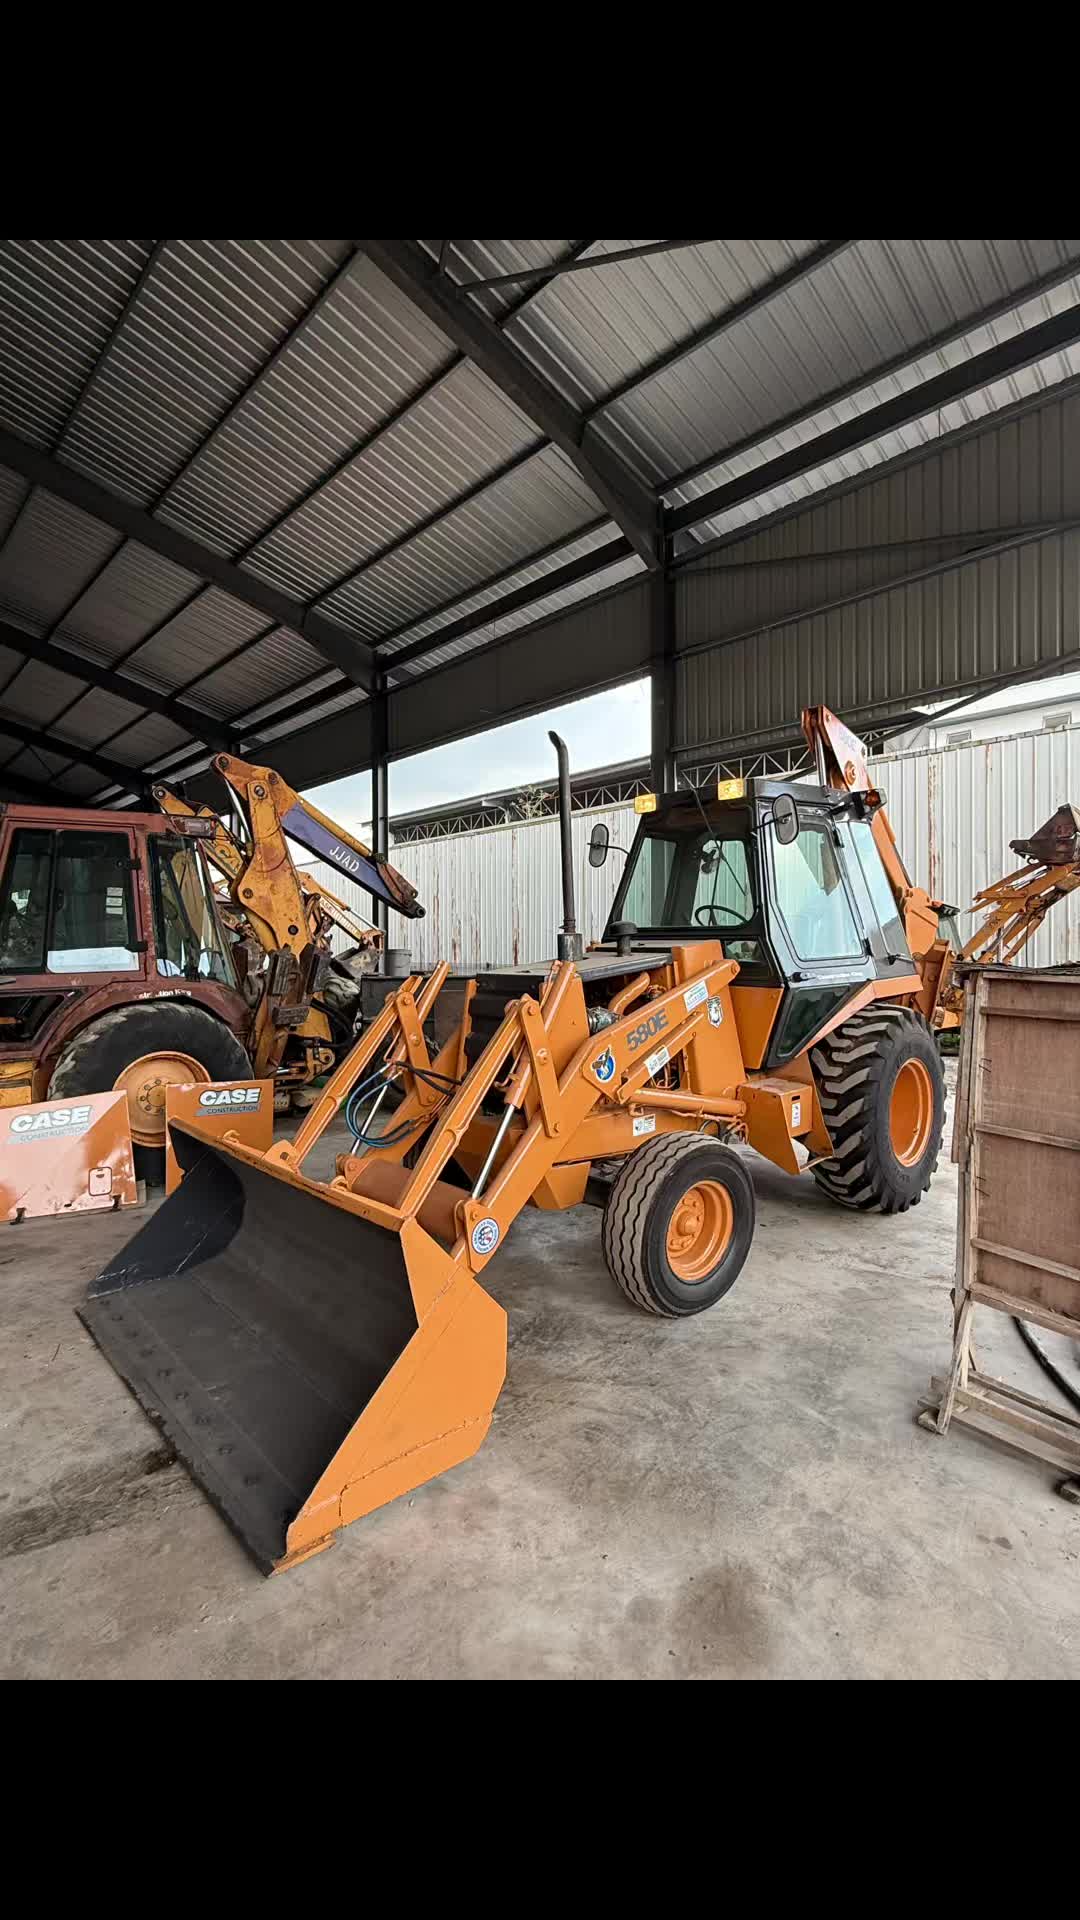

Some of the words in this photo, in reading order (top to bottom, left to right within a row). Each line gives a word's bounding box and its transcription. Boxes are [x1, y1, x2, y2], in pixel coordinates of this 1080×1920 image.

[329, 846, 360, 873] JJAD
[627, 1006, 669, 1052] 580E
[198, 1087, 262, 1107] CASE
[207, 1104, 258, 1115] CONSTRUCTION
[10, 1105, 92, 1133] CASE
